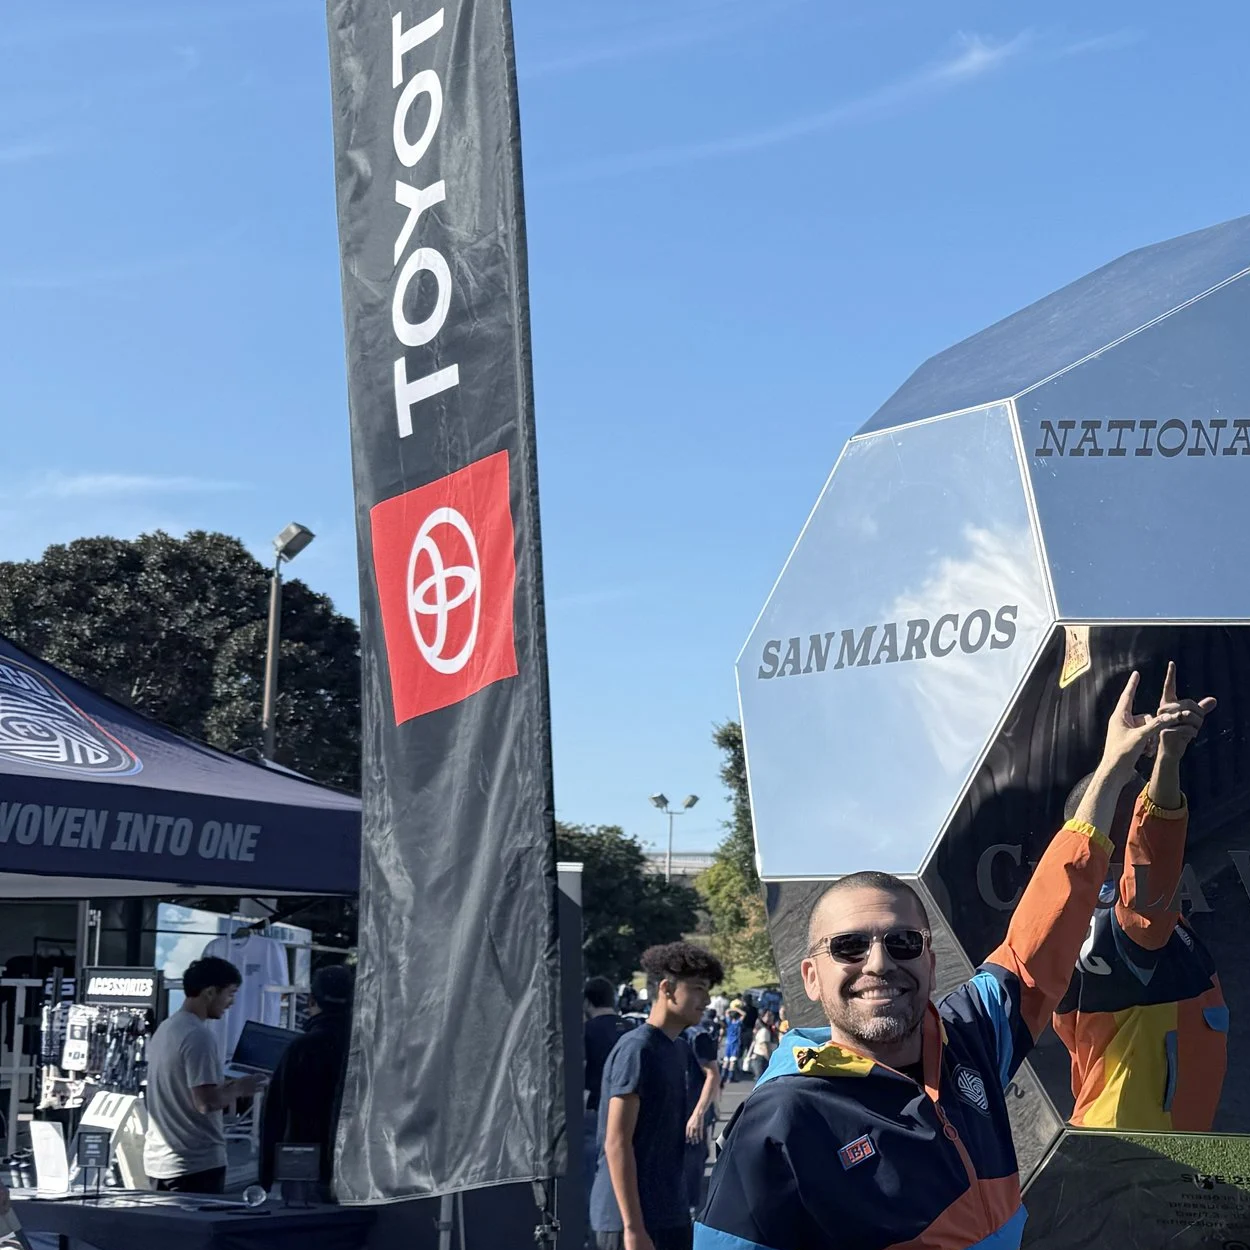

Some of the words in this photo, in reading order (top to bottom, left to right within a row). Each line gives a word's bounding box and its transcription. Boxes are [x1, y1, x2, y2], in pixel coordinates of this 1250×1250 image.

[9, 721, 50, 738] FC
[0, 801, 109, 850] WOVEN
[110, 811, 194, 857] INTO
[198, 819, 262, 862] ONE
[975, 843, 1217, 914] CLA
[87, 977, 154, 997] ACCESSORIES
[1180, 1173, 1226, 1186] SIZE
